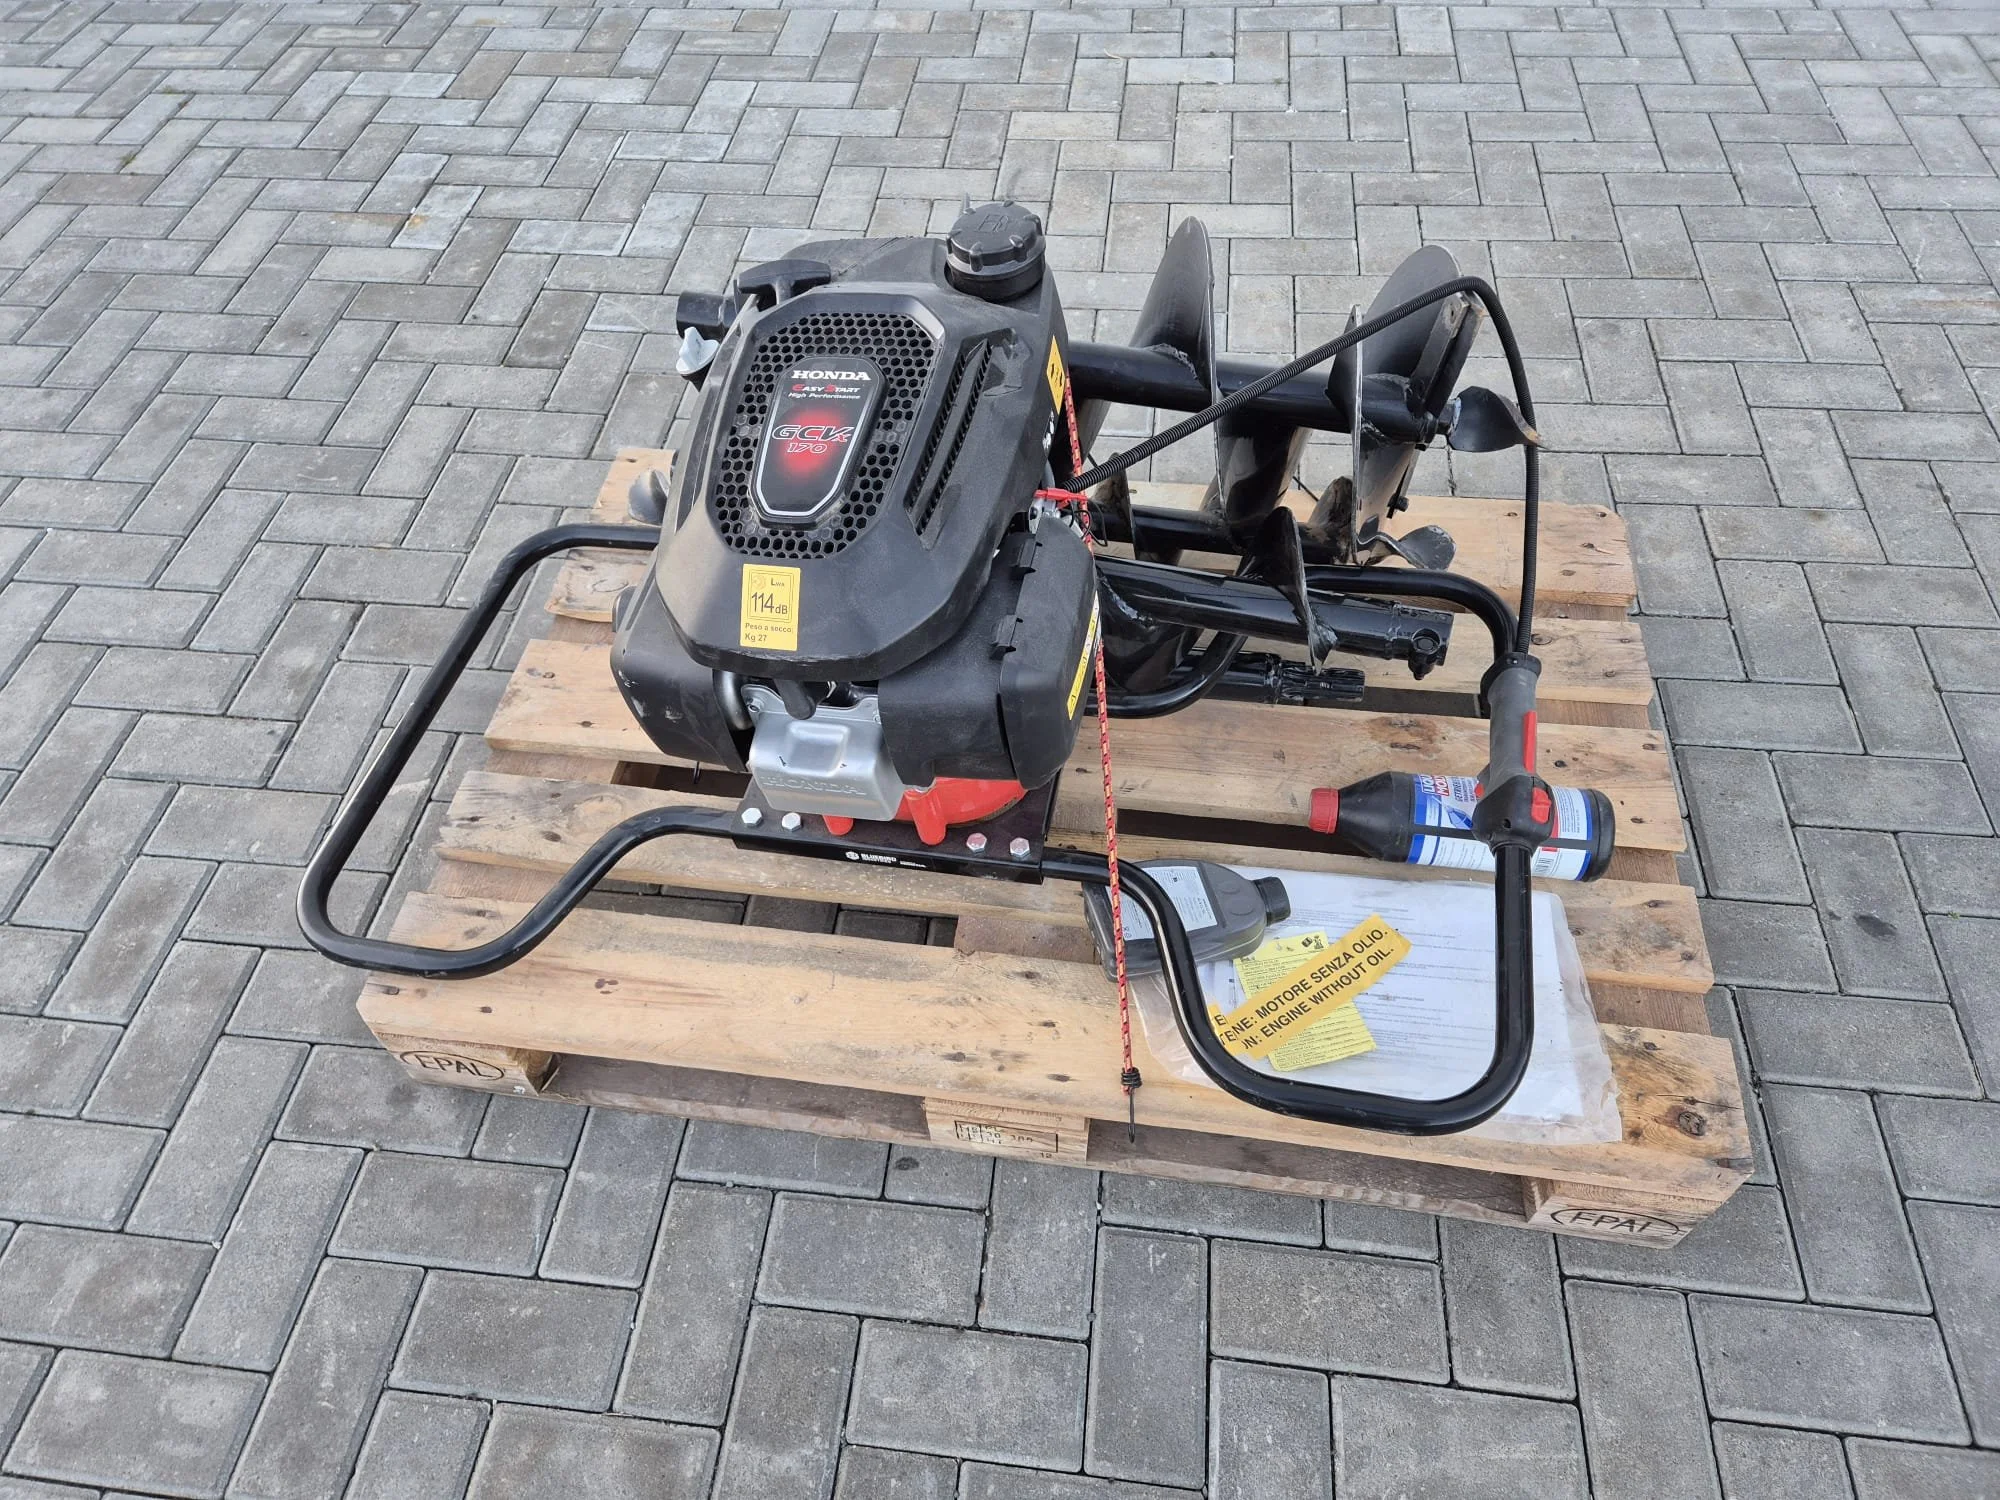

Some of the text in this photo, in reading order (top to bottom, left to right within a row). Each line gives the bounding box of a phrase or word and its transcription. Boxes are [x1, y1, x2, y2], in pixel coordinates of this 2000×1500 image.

[791, 370, 872, 381] HONDA
[787, 442, 828, 454] 170
[745, 622, 763, 631] Peso
[744, 632, 767, 642] Kg 27
[1255, 979, 1312, 1019] MOTORE
[1310, 951, 1355, 983] SENZA
[1352, 929, 1388, 955] OLIO.
[1260, 1001, 1312, 1038] ENGINE
[1308, 962, 1367, 1005] WITHOUT
[1366, 948, 1395, 967] OIL.
[414, 1053, 496, 1078] EPAL
